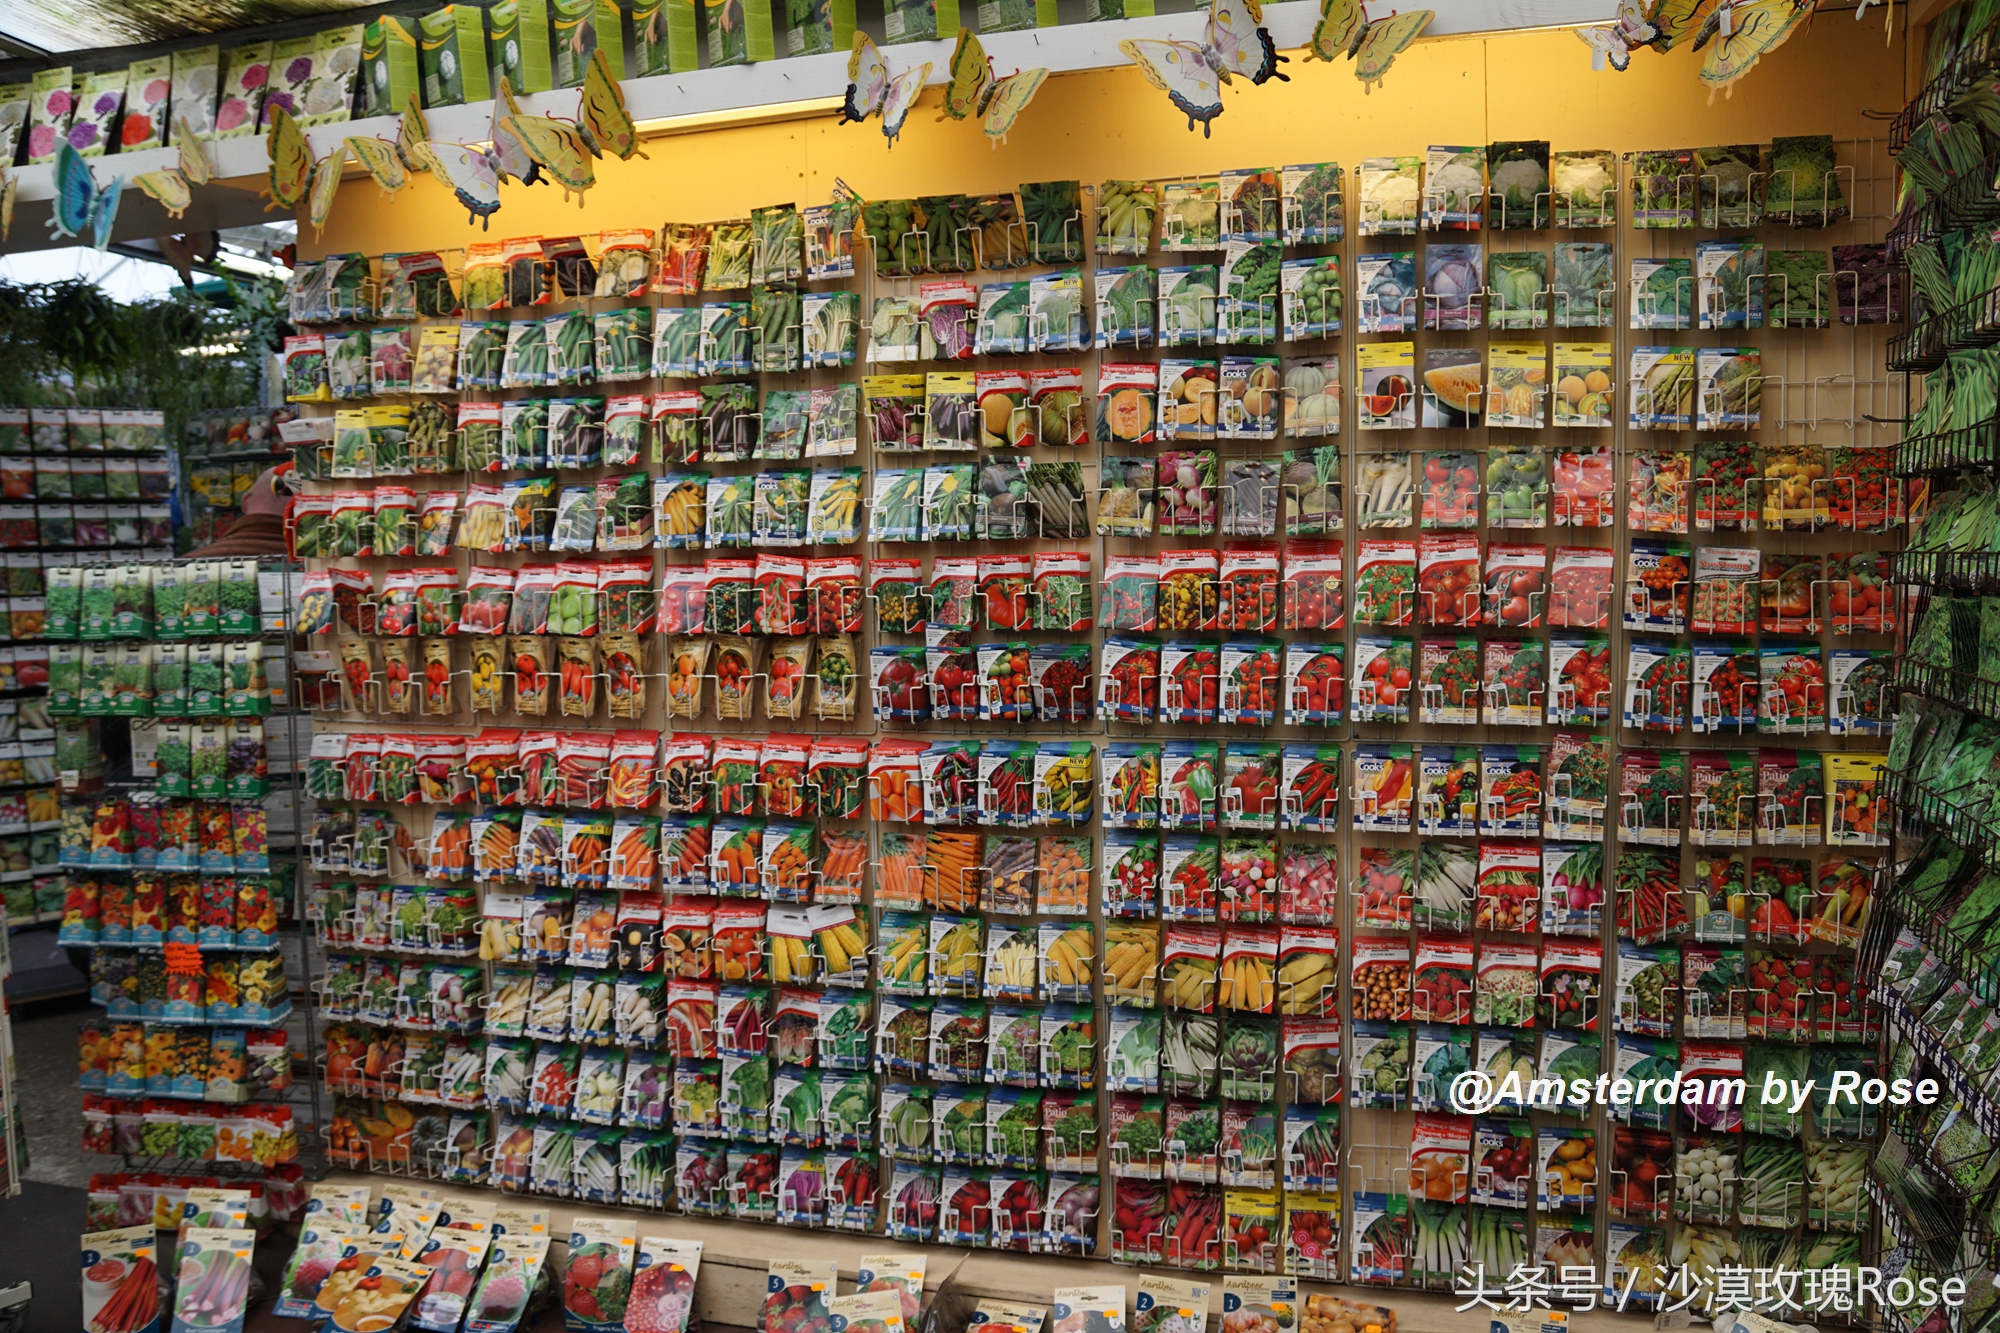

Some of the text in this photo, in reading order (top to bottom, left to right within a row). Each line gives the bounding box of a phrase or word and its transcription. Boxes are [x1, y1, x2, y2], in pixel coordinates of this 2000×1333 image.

[812, 395, 832, 403] Patio
[1423, 652, 1448, 661] Patio
[1488, 652, 1514, 661] Patio
[1556, 741, 1581, 752] Patio
[1626, 772, 1651, 780] Patio
[1696, 773, 1721, 781] Patio
[1763, 771, 1789, 780] Patio
[1687, 960, 1714, 969] Patio
[1045, 1108, 1067, 1116] Patio
[1112, 1112, 1134, 1120] Patio
[1169, 1110, 1191, 1119] Patio
[1225, 1118, 1247, 1127] Patio
[772, 1262, 804, 1271] Aardbei
[863, 1272, 869, 1281] 5
[772, 1278, 779, 1288] 5
[1142, 1280, 1174, 1291] Aardbei
[1227, 1280, 1264, 1289] Aardpeer
[1058, 1290, 1090, 1298] Aardbei
[831, 1299, 865, 1308] Aardbei
[1140, 1297, 1148, 1308] 2
[1229, 1299, 1233, 1309] 1
[980, 1304, 1011, 1313] Aardbei
[1058, 1306, 1064, 1315] 5
[835, 1317, 841, 1327] 5
[976, 1314, 983, 1322] 5
[1743, 1313, 1784, 1333] Rabarber
